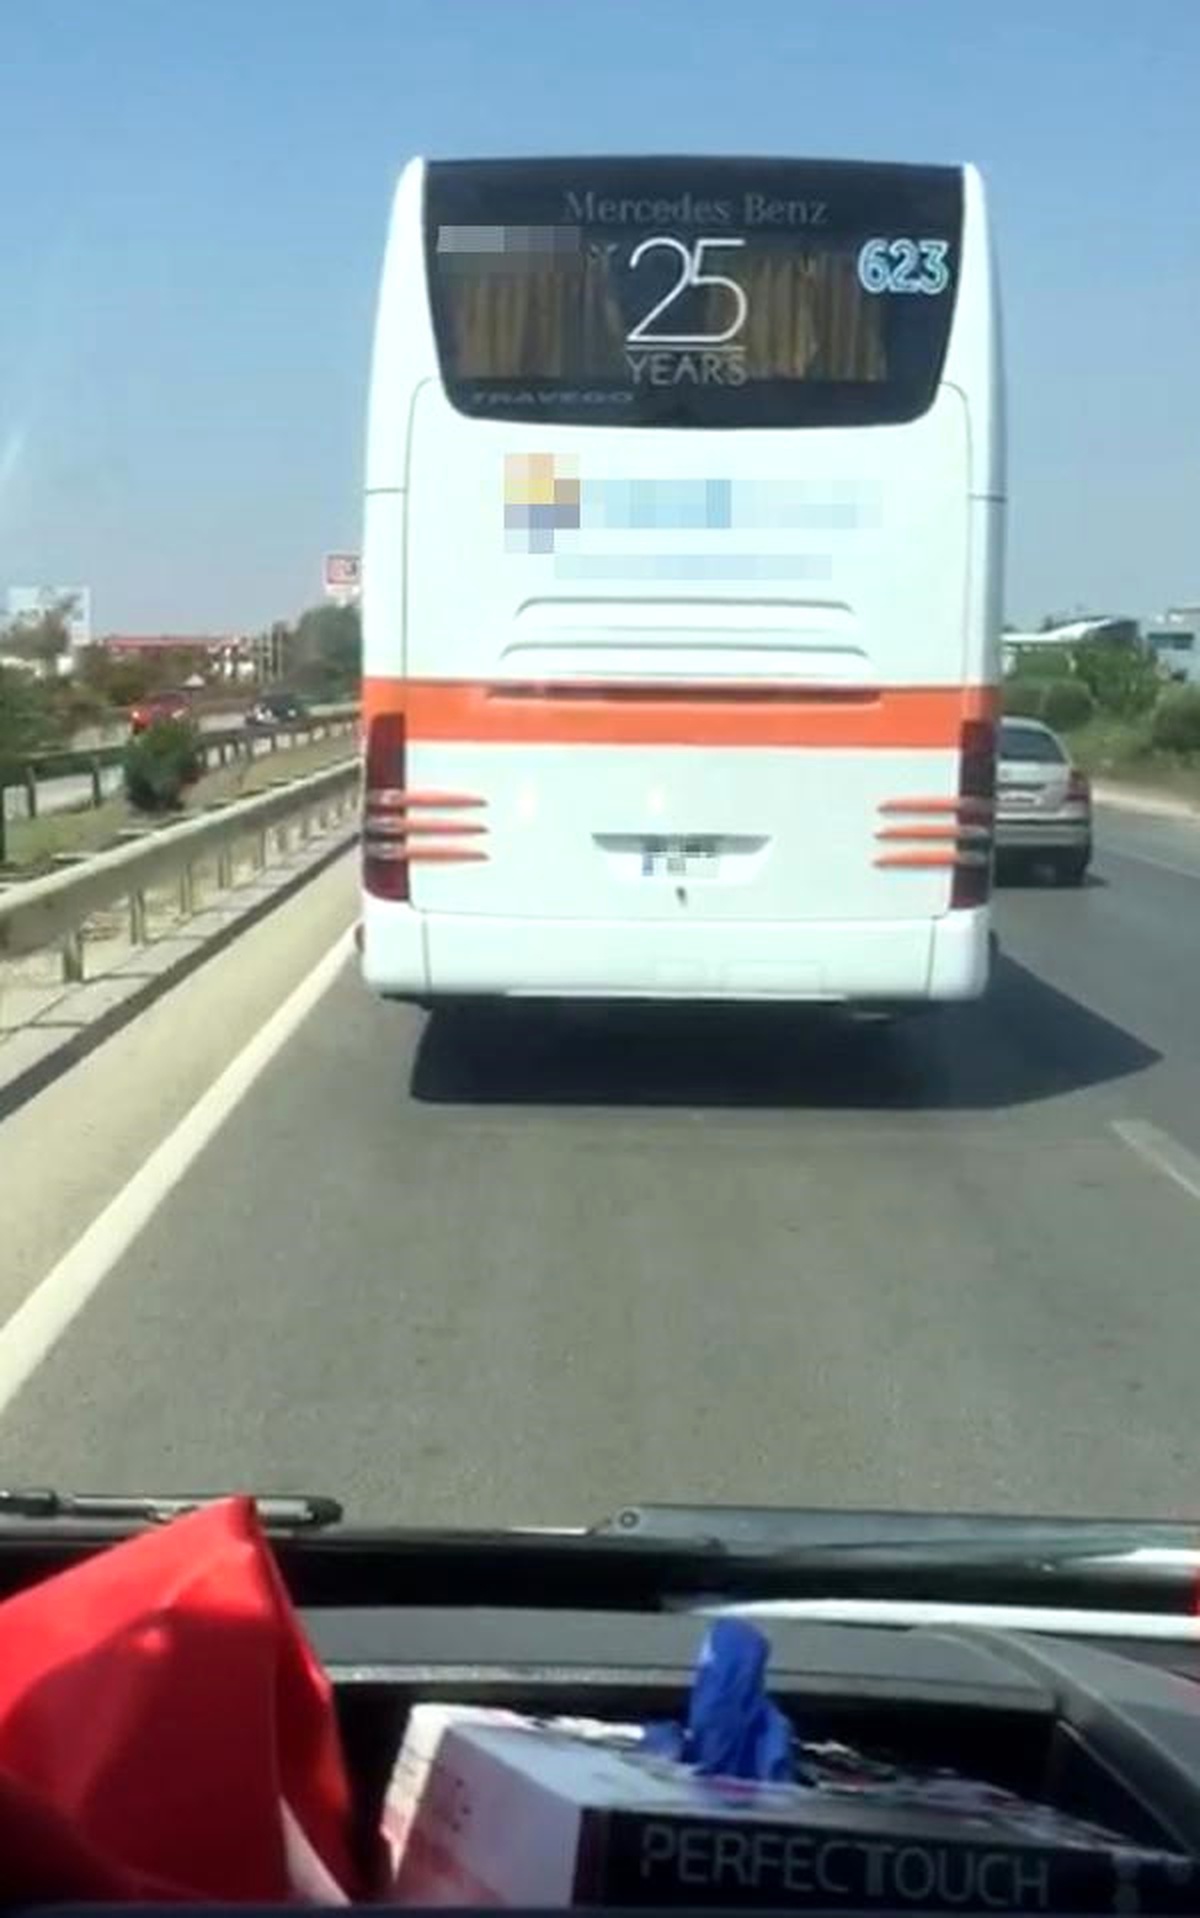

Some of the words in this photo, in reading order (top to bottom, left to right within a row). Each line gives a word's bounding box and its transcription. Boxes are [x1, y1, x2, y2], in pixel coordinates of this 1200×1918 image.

[564, 192, 731, 225] Mercedes
[745, 194, 829, 225] Benz
[858, 239, 950, 294] 623
[626, 237, 748, 343] 25
[626, 354, 747, 386] YEARS
